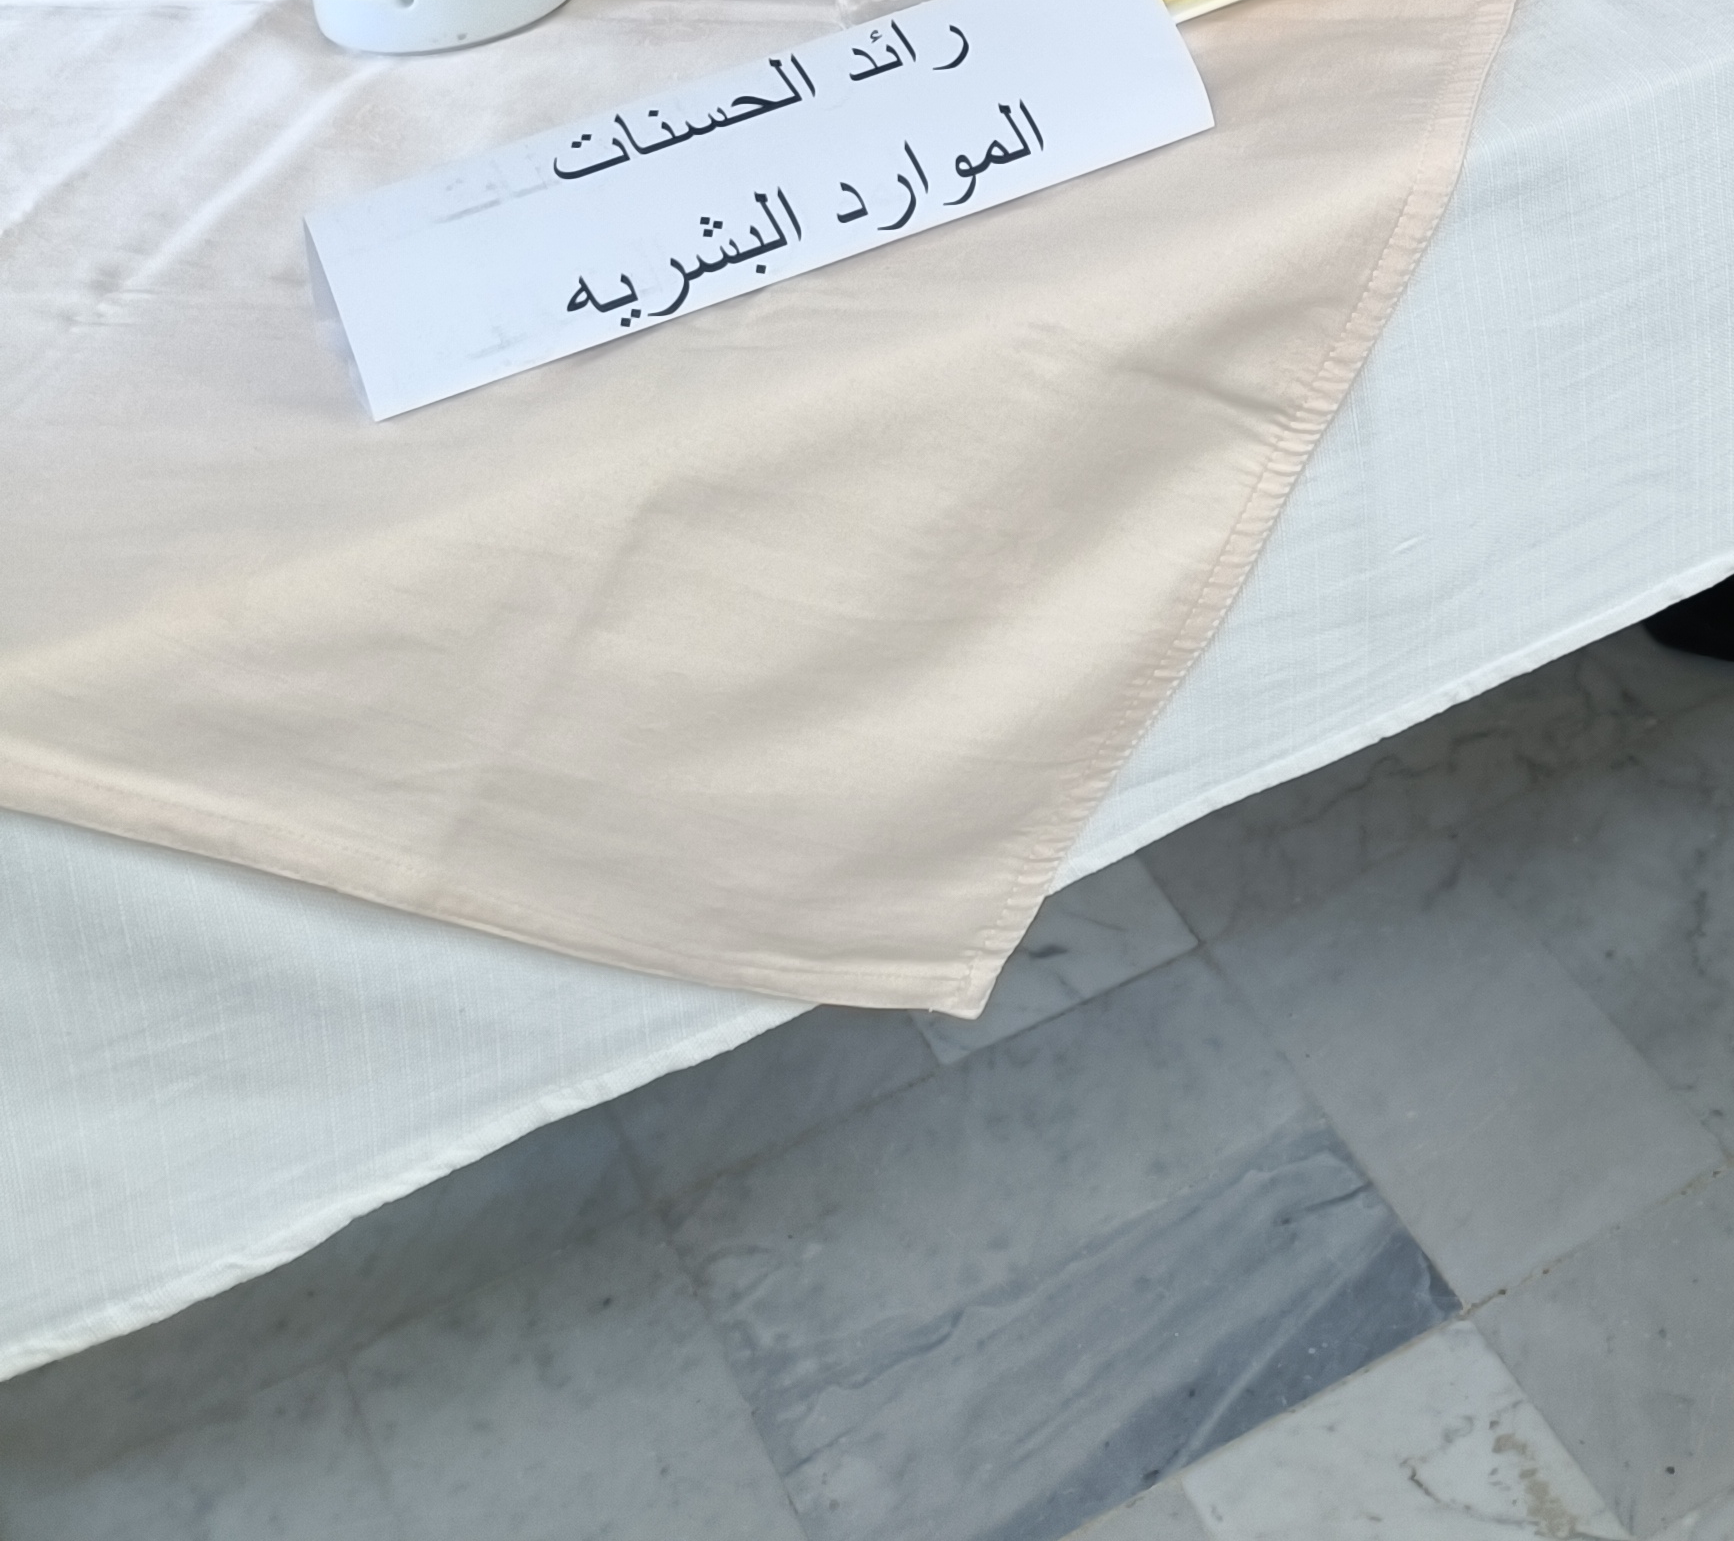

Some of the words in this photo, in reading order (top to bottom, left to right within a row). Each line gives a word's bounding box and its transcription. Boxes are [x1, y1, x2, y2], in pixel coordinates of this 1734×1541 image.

[847, 18, 971, 82] رائد
[552, 53, 817, 182] الحسنات
[832, 99, 1045, 231] الموارد
[564, 187, 803, 329] البشريه
